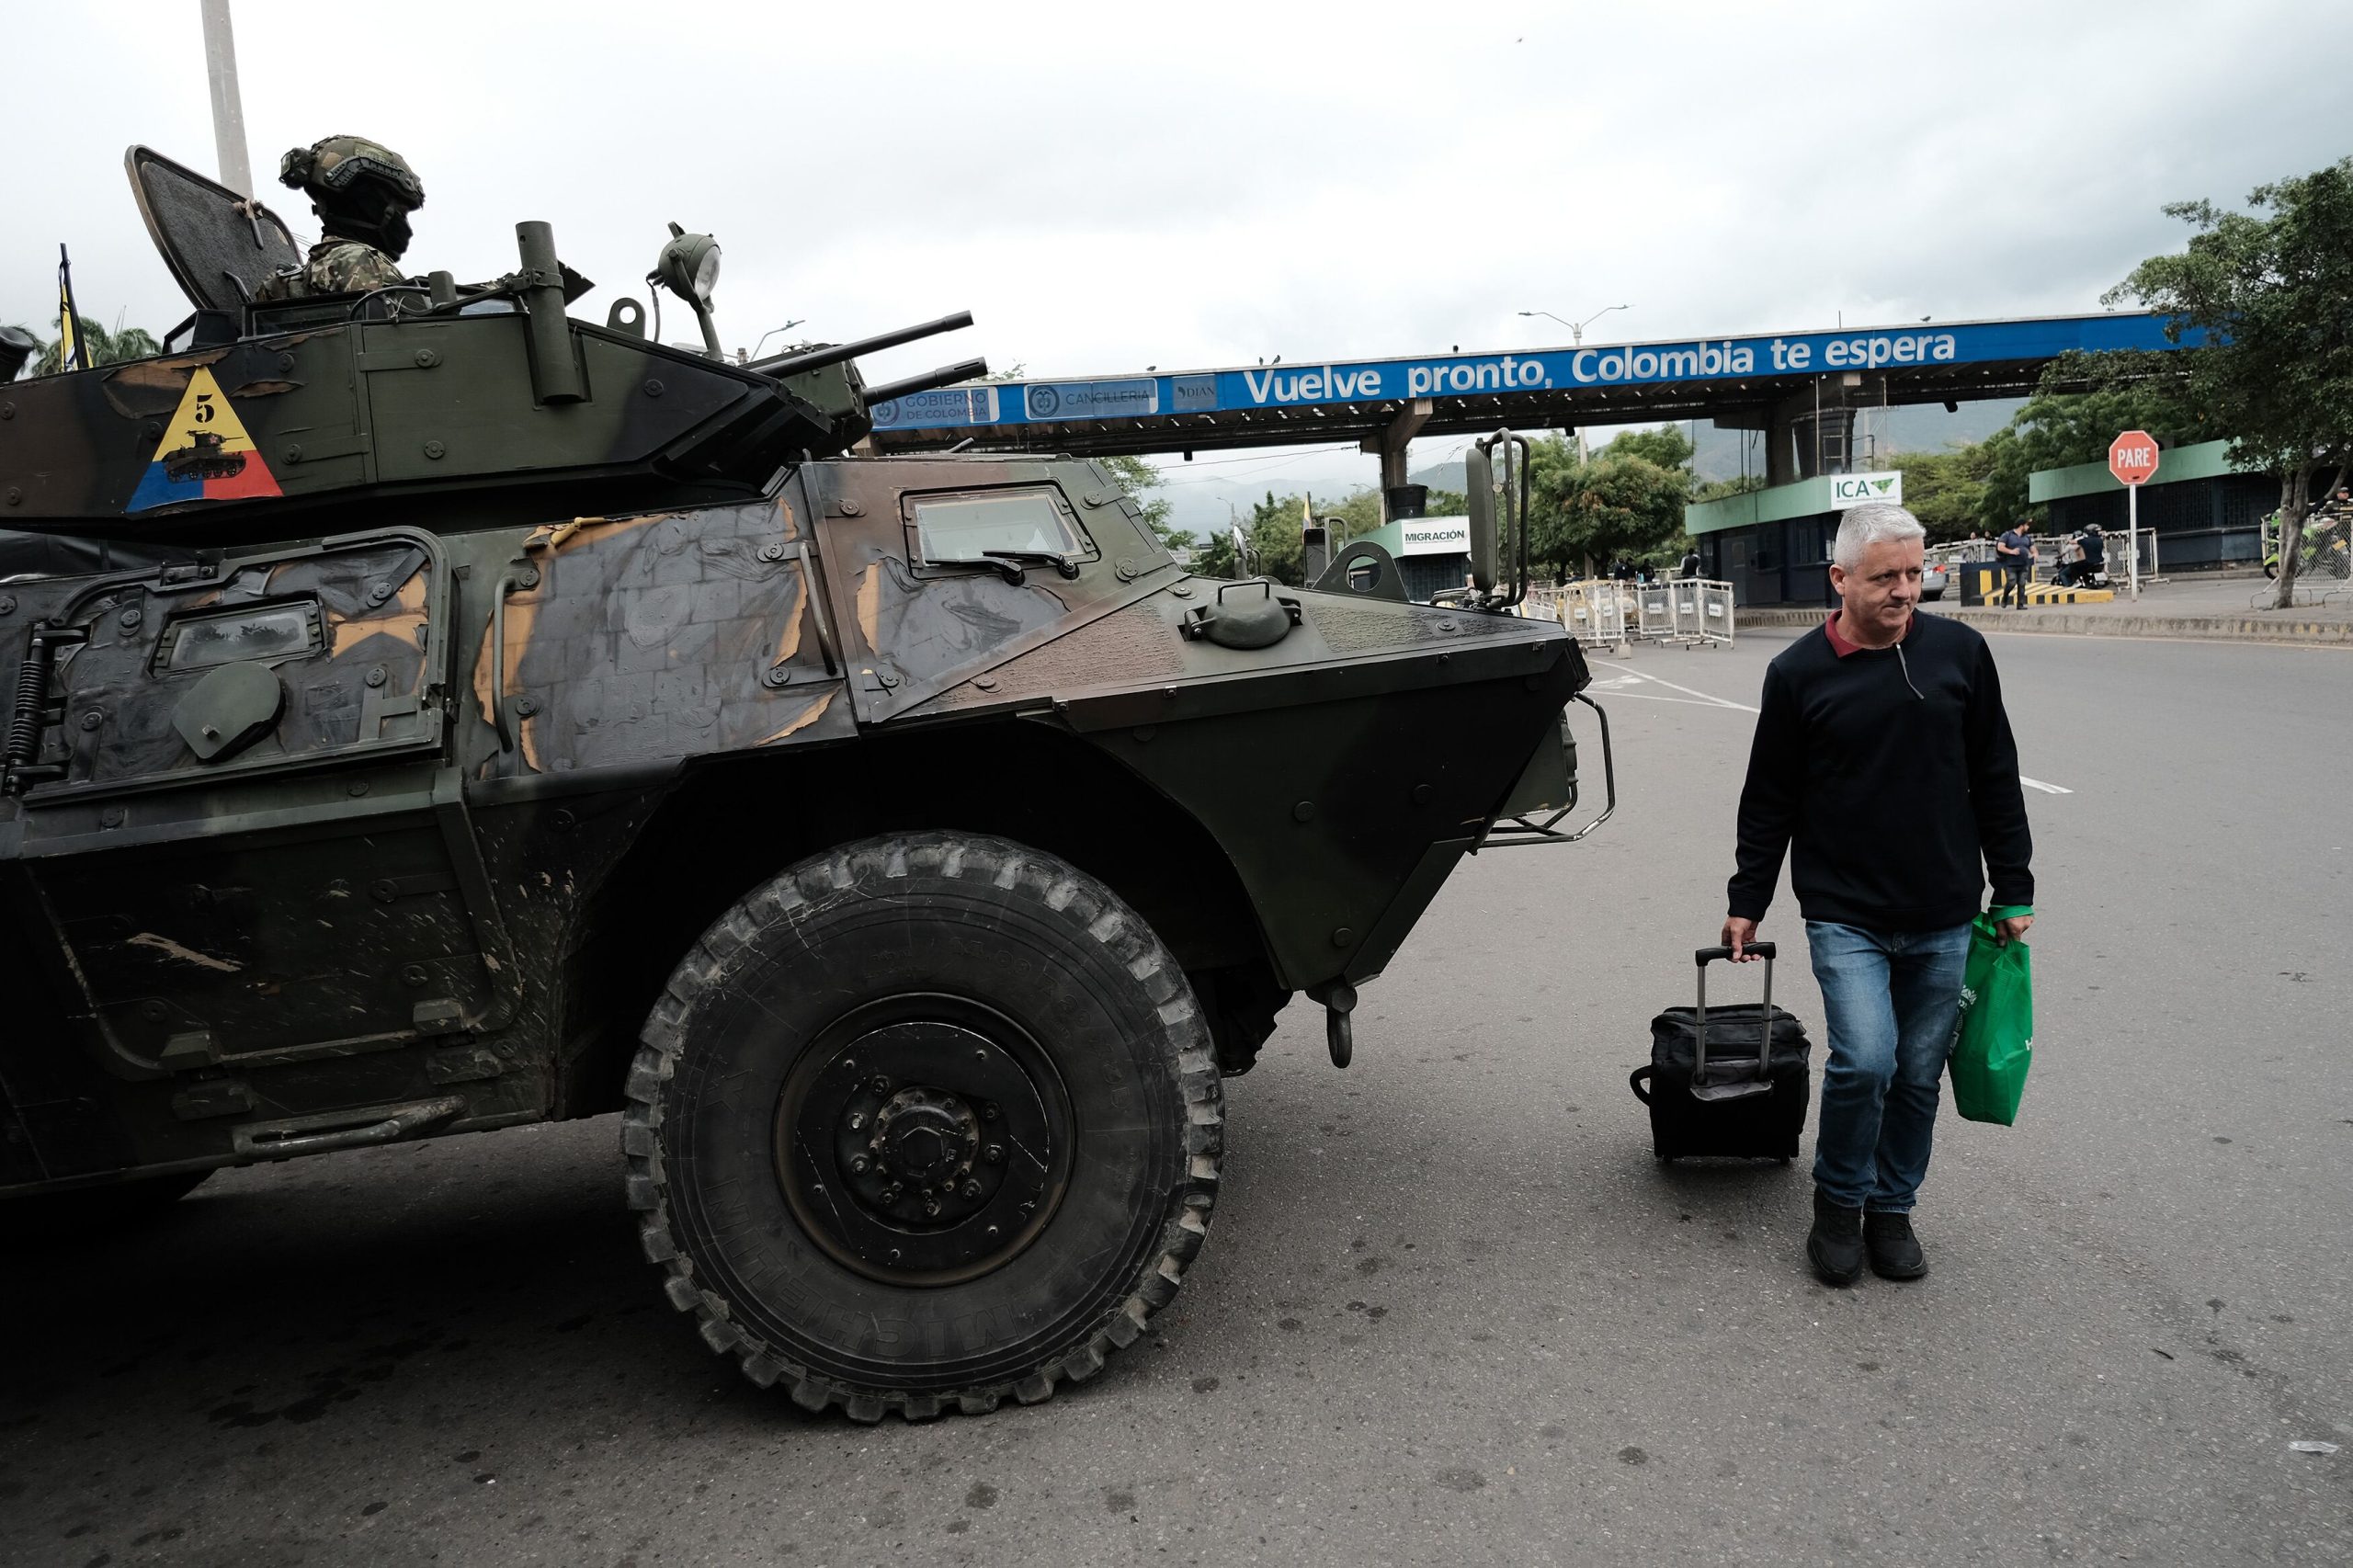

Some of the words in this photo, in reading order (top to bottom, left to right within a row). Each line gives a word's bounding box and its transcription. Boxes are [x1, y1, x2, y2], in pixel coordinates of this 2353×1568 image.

[1244, 365, 1381, 403] Vuelve
[1408, 357, 1553, 397] pronto,
[1573, 341, 1754, 383] Colombia
[1770, 339, 1811, 369] te
[1824, 334, 1956, 369] espera
[905, 392, 986, 407] GOBIERNO
[1186, 387, 1215, 398] DIAN
[195, 393, 215, 423] 5
[906, 411, 922, 420] DE
[925, 407, 987, 419] COLOMBIA
[2117, 447, 2151, 468] PARE
[1836, 480, 1870, 498] ICA
[1405, 529, 1465, 541] MIGRACIÓN
[703, 1178, 1019, 1358] MICHELIN
